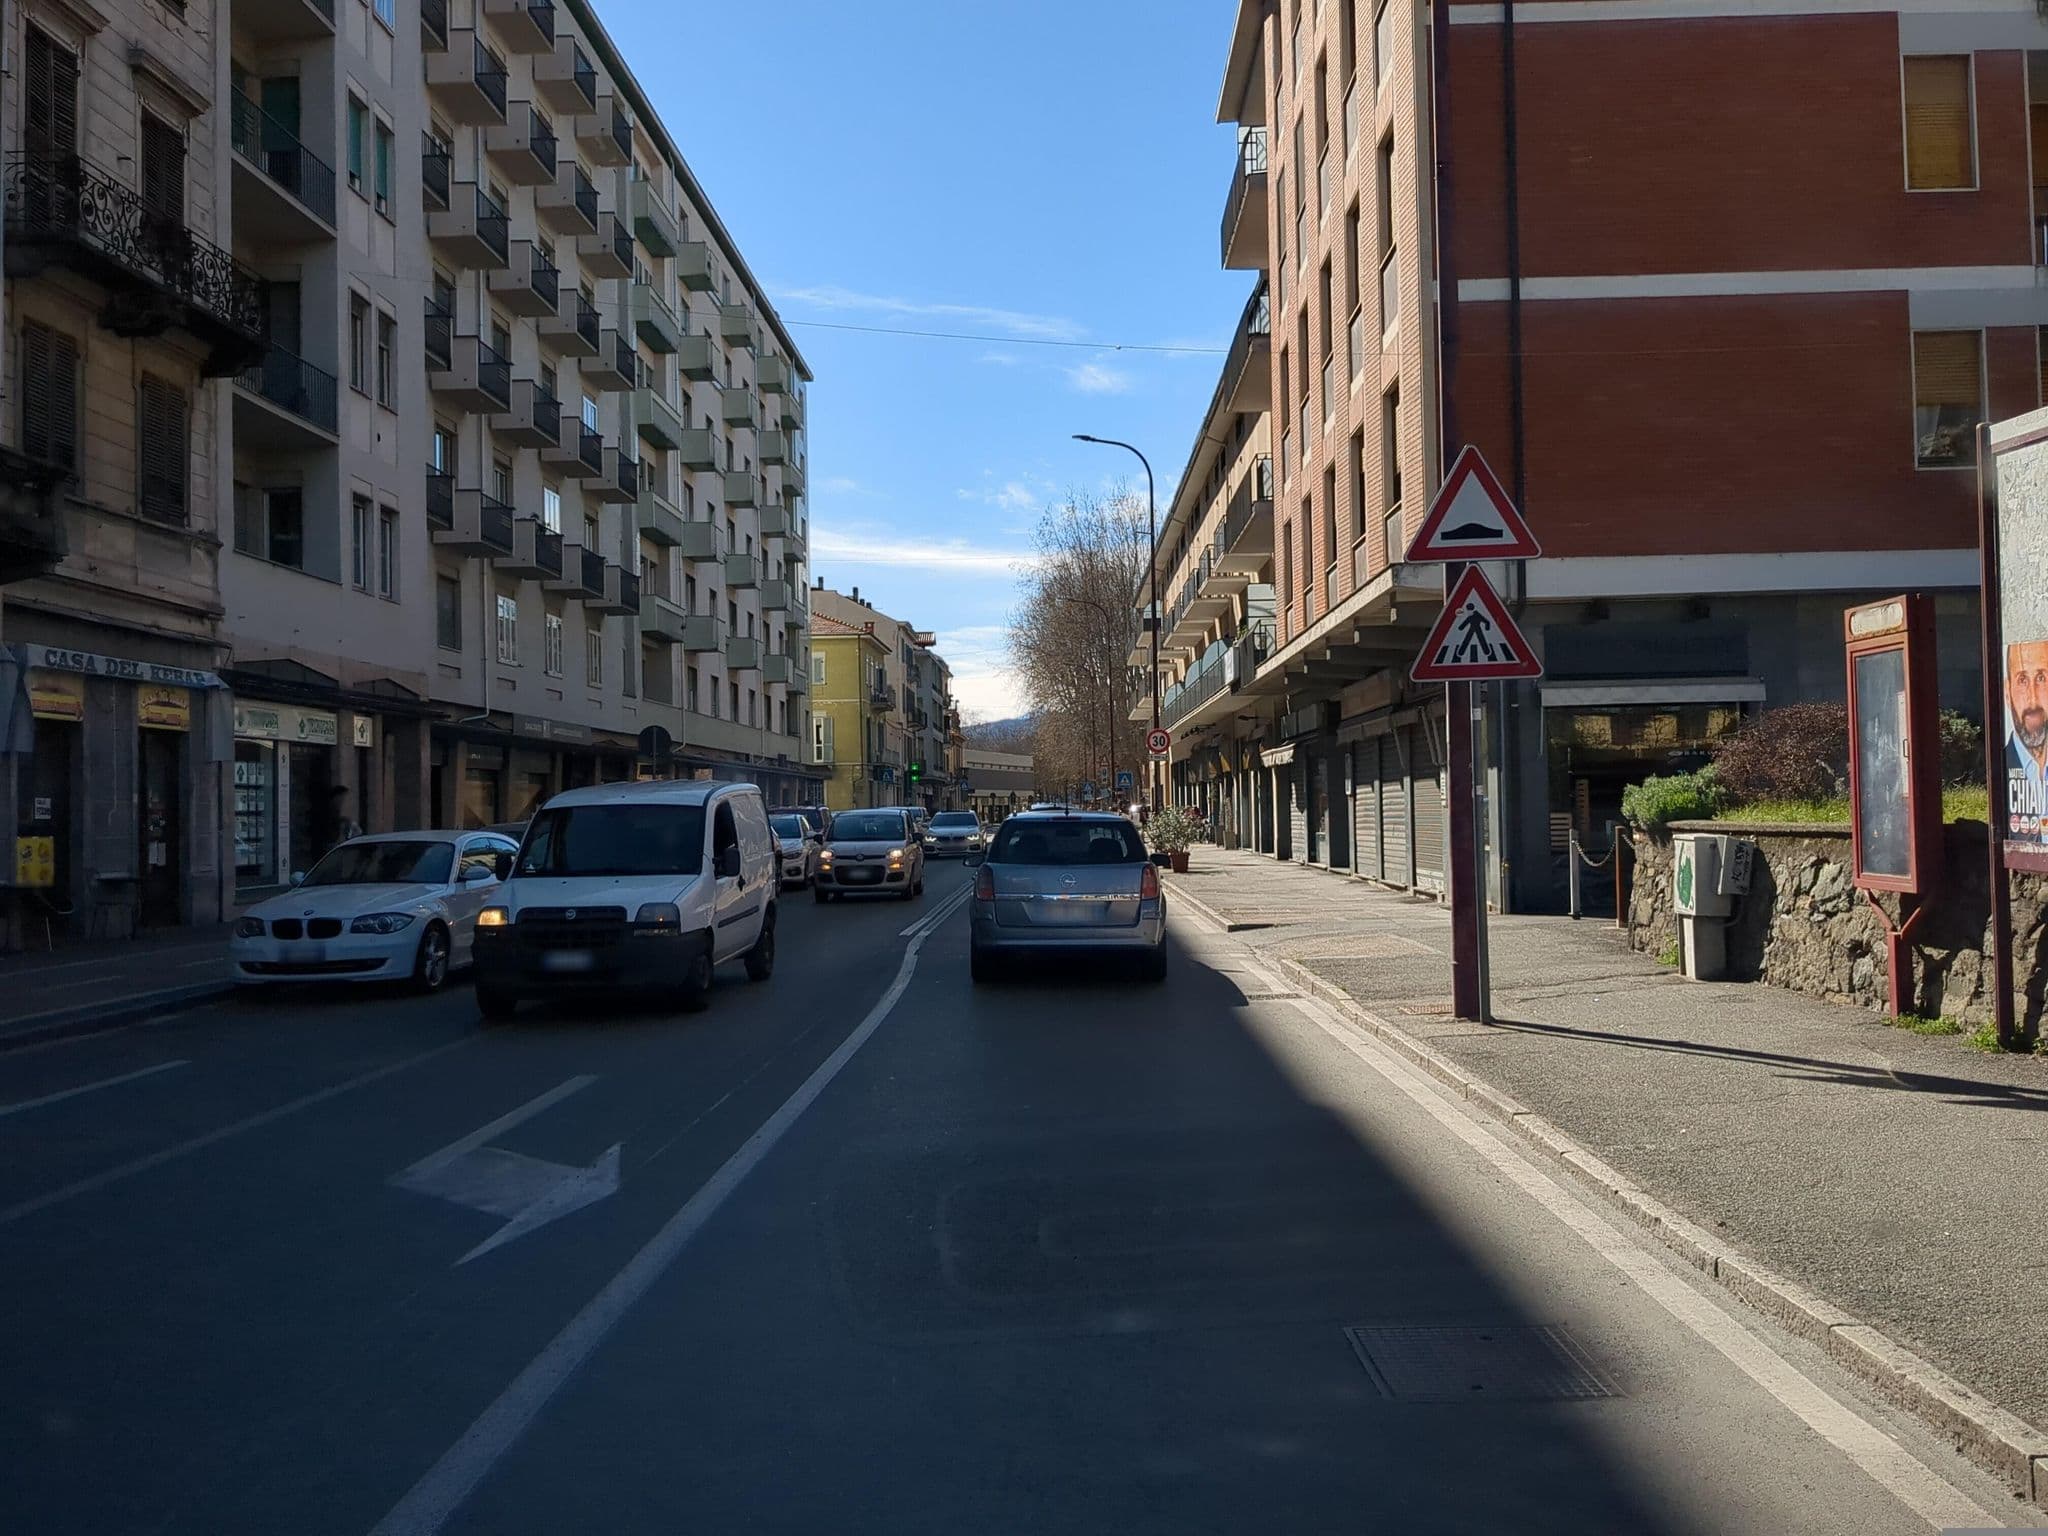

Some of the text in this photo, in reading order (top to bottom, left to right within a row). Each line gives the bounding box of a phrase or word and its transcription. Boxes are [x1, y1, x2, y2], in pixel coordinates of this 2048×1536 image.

[44, 649, 97, 674] CASA
[105, 658, 144, 678] DEL
[1152, 735, 1166, 747] 30
